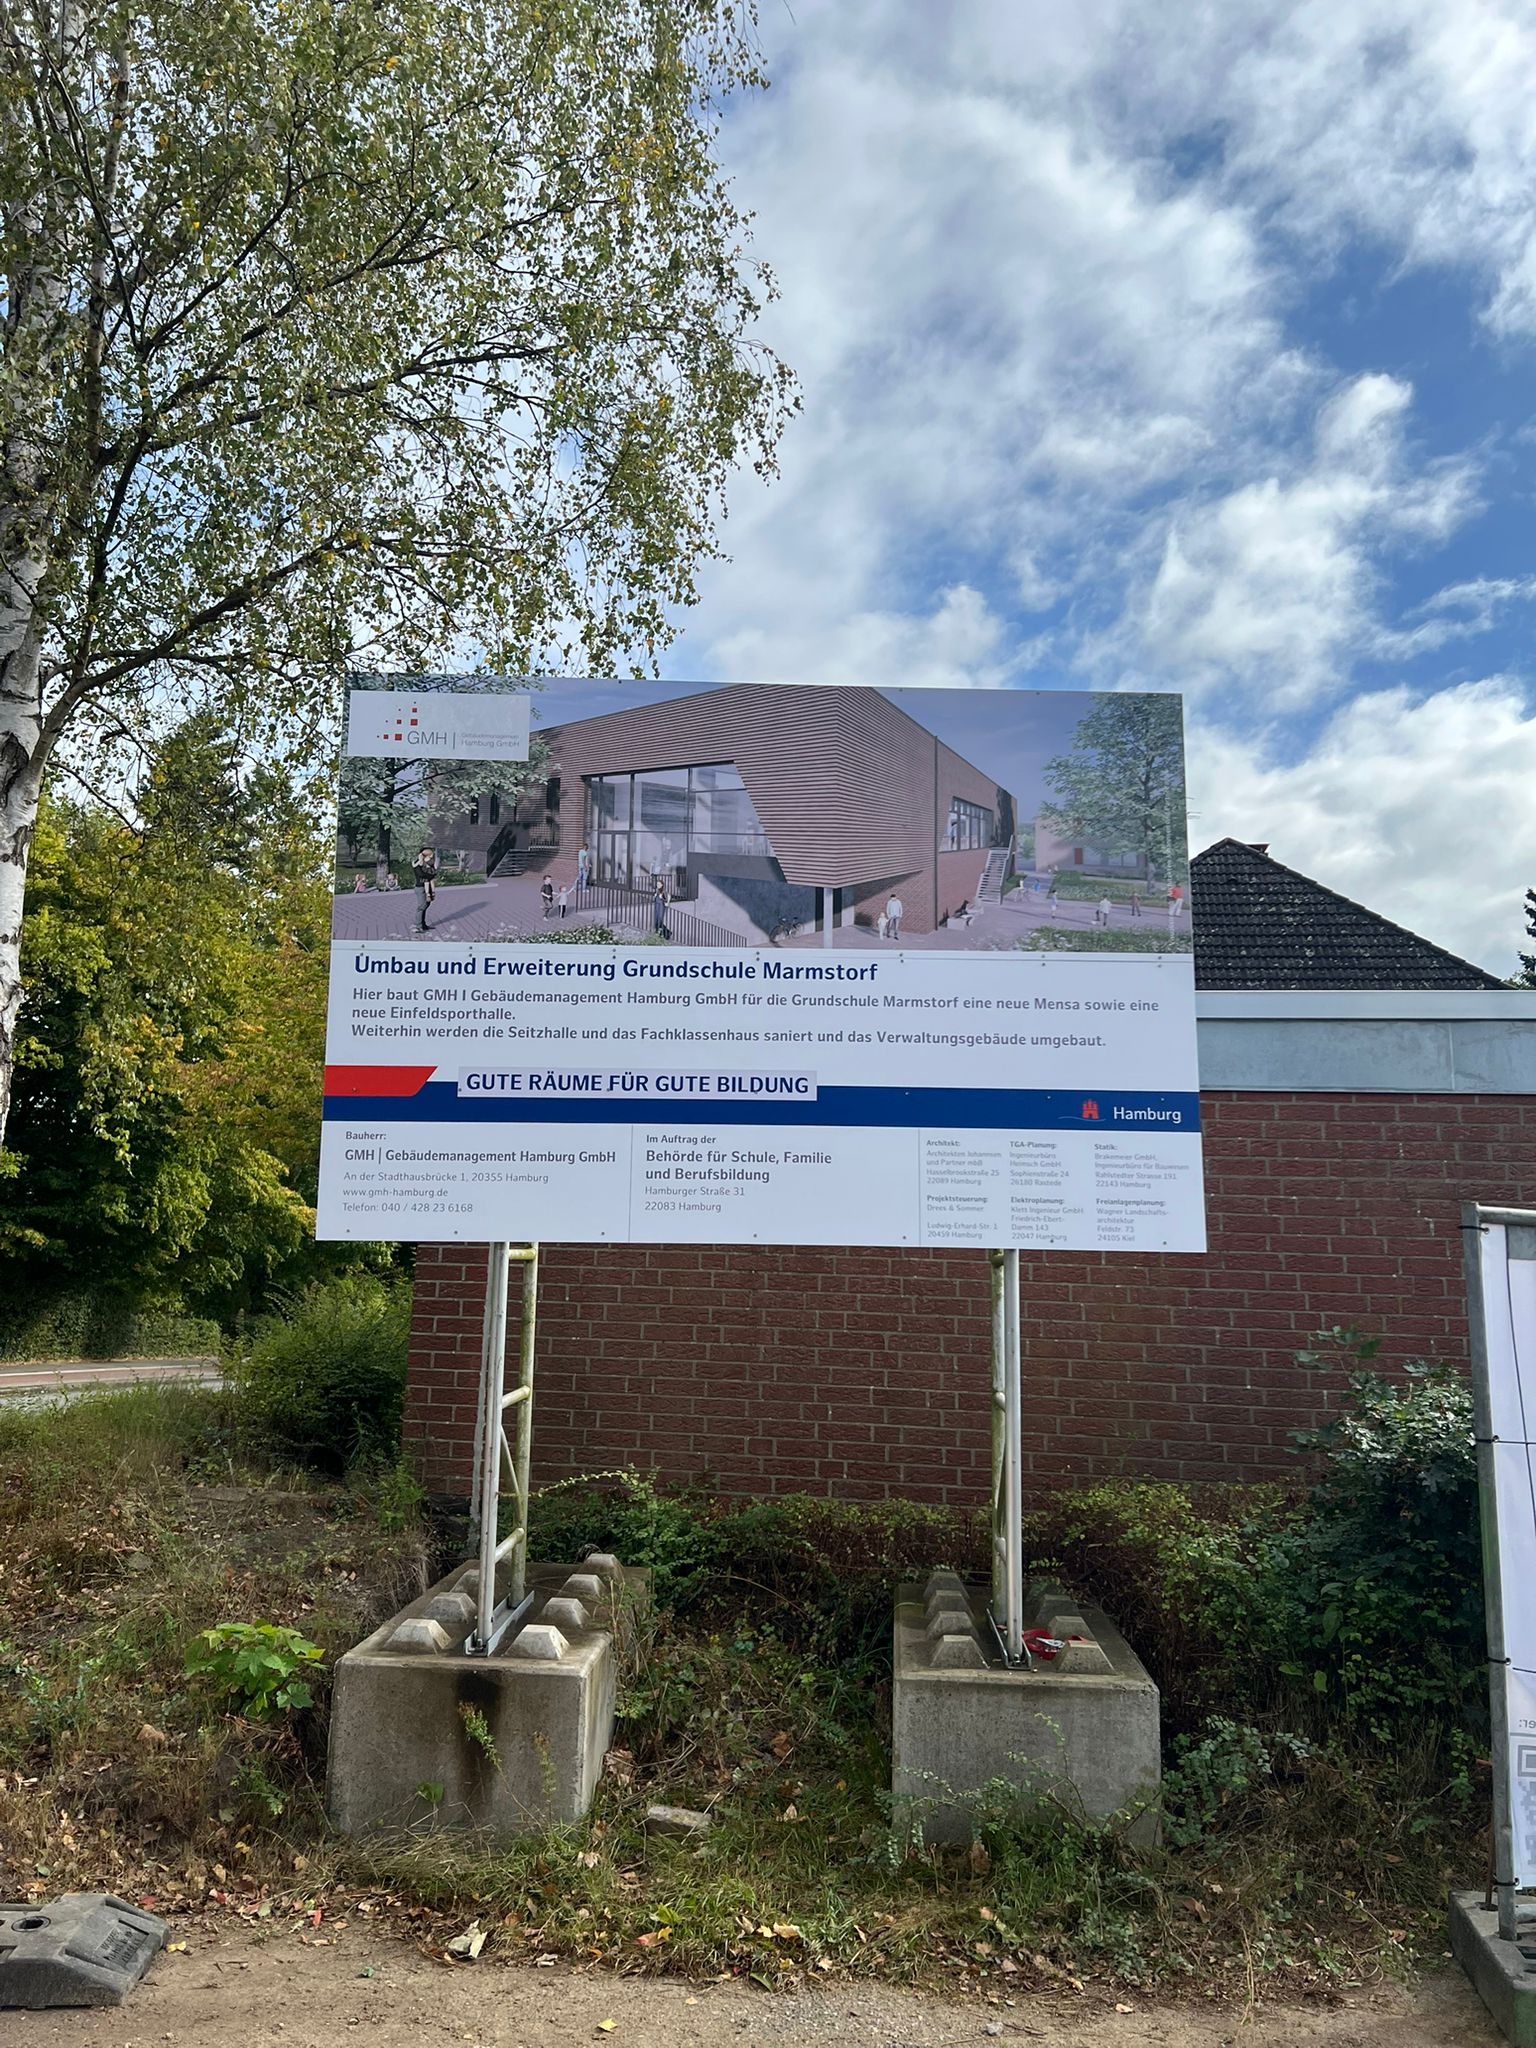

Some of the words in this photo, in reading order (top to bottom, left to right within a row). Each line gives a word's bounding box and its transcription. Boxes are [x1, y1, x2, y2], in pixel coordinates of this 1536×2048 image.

[407, 730, 447, 745] GMH
[355, 955, 429, 974] Umbau
[437, 956, 476, 975] und
[484, 957, 615, 980] Erweiterung
[623, 960, 756, 979] Grundschule
[764, 962, 878, 980] Marmstorf
[353, 988, 383, 1000] Hier
[387, 988, 419, 1001] baut
[423, 989, 458, 1001] GMH
[471, 990, 623, 1006] Gebäudemanagement
[627, 992, 691, 1007] Hamburg
[695, 993, 737, 1005] GmbH
[742, 993, 763, 1005] für
[767, 994, 787, 1006] die
[792, 994, 879, 1007] Grundschule
[883, 996, 959, 1008] Marmstorf
[963, 997, 992, 1009] eine
[997, 1000, 1030, 1009] neue
[1034, 998, 1080, 1010] Mensa
[1084, 999, 1125, 1011] sowie
[1130, 1000, 1159, 1011] eine
[352, 1009, 386, 1018] neue
[390, 1006, 515, 1022] Einfeldsporthalle.
[351, 1024, 421, 1037] Weiterhin
[426, 1026, 478, 1038] werden
[483, 1026, 504, 1038] die
[508, 1026, 578, 1039] Seitzhalle
[582, 1027, 608, 1039] und
[612, 1028, 636, 1040] das
[641, 1028, 760, 1041] Fachklassenhaus
[764, 1030, 813, 1042] saniert
[818, 1030, 843, 1042] und
[848, 1031, 872, 1043] das
[877, 1031, 1026, 1047] Verwaltungsgebäude
[1031, 1034, 1106, 1048] umgebaut.
[467, 1074, 522, 1090] GUTE
[529, 1071, 602, 1091] RÄUME
[608, 1072, 648, 1092] FÜR
[656, 1076, 710, 1092] GUTE
[717, 1076, 808, 1094] BILDUNG
[1114, 1106, 1182, 1124] Hamburg
[346, 1131, 387, 1140] Bauherr:
[646, 1134, 658, 1143] Im
[661, 1135, 698, 1146] Auftrag
[700, 1136, 716, 1144] der
[345, 1149, 374, 1161] GMH
[386, 1150, 516, 1164] Gebäudemanagement
[520, 1151, 575, 1165] Hamburg
[579, 1151, 616, 1163] GmbH
[646, 1150, 703, 1162] Behörde
[707, 1151, 727, 1162] für
[731, 1151, 779, 1165] Schule,
[784, 1152, 832, 1164] Familie
[344, 1172, 357, 1180] An
[359, 1172, 375, 1181] der
[378, 1172, 457, 1182] Stadthausbrücke
[461, 1172, 469, 1182] 1,
[472, 1172, 503, 1182] 20355
[506, 1173, 549, 1184] Hamburg
[646, 1168, 670, 1180] und
[675, 1168, 770, 1183] Berufsbildung
[343, 1187, 448, 1199] www.gmh-hamburg.de
[645, 1186, 697, 1198] Hamburger
[700, 1186, 730, 1196] Straße
[733, 1187, 745, 1196] 31
[342, 1202, 378, 1212] Telefon:
[381, 1202, 401, 1212] 040
[403, 1203, 408, 1212] /
[410, 1203, 430, 1212] 428
[433, 1203, 445, 1212] 23
[448, 1203, 473, 1213] 6168
[645, 1201, 676, 1211] 22083
[679, 1202, 722, 1214] Hamburg
